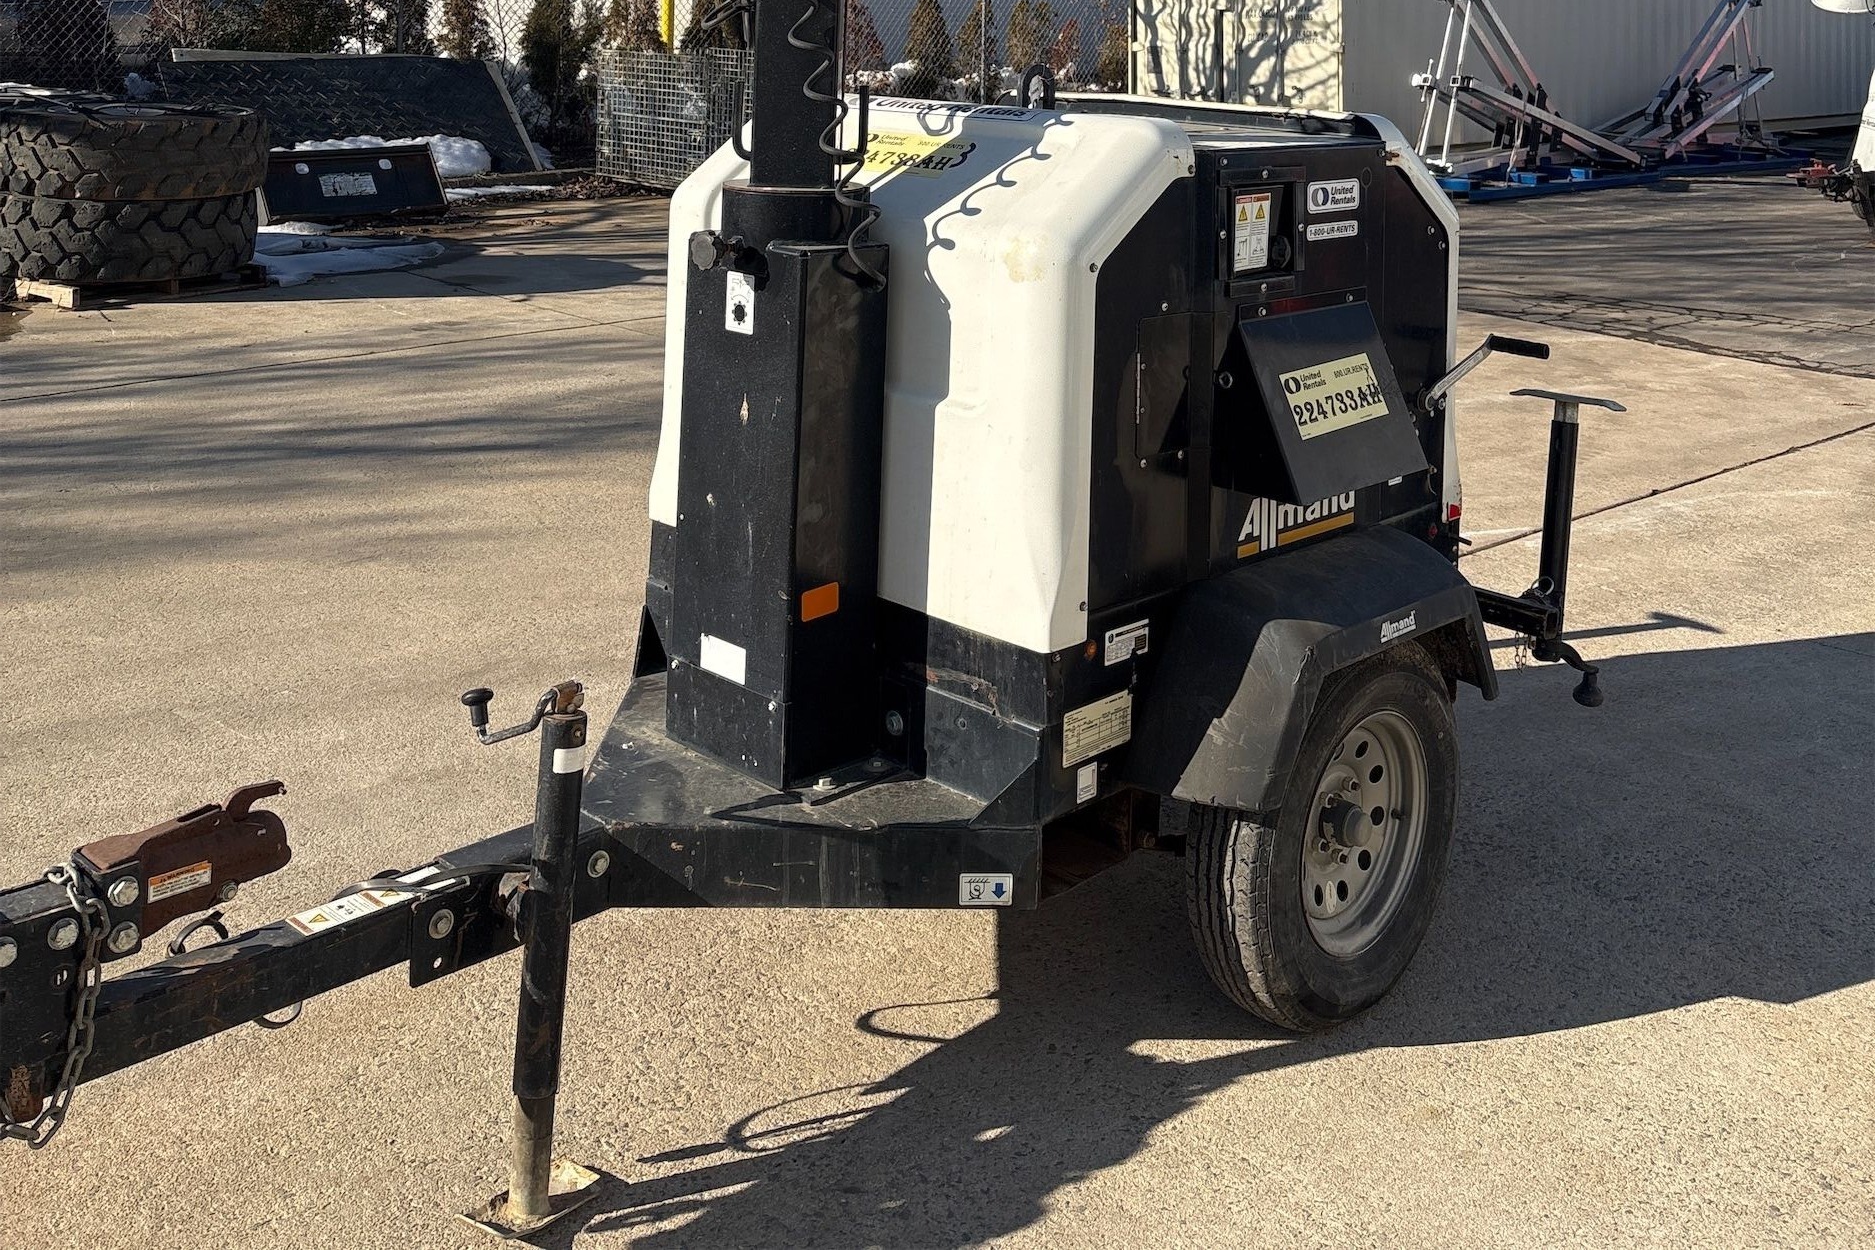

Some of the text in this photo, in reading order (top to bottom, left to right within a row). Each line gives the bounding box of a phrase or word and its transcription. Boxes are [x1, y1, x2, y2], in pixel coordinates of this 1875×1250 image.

[1330, 184, 1355, 196] United
[1330, 194, 1356, 206] Rentals
[1309, 224, 1356, 237] 1-800-UR-RENTS
[1300, 370, 1322, 383] United
[1303, 379, 1327, 391] Rentals
[1293, 383, 1383, 427] 224733AH
[1380, 610, 1416, 639] Allmand
